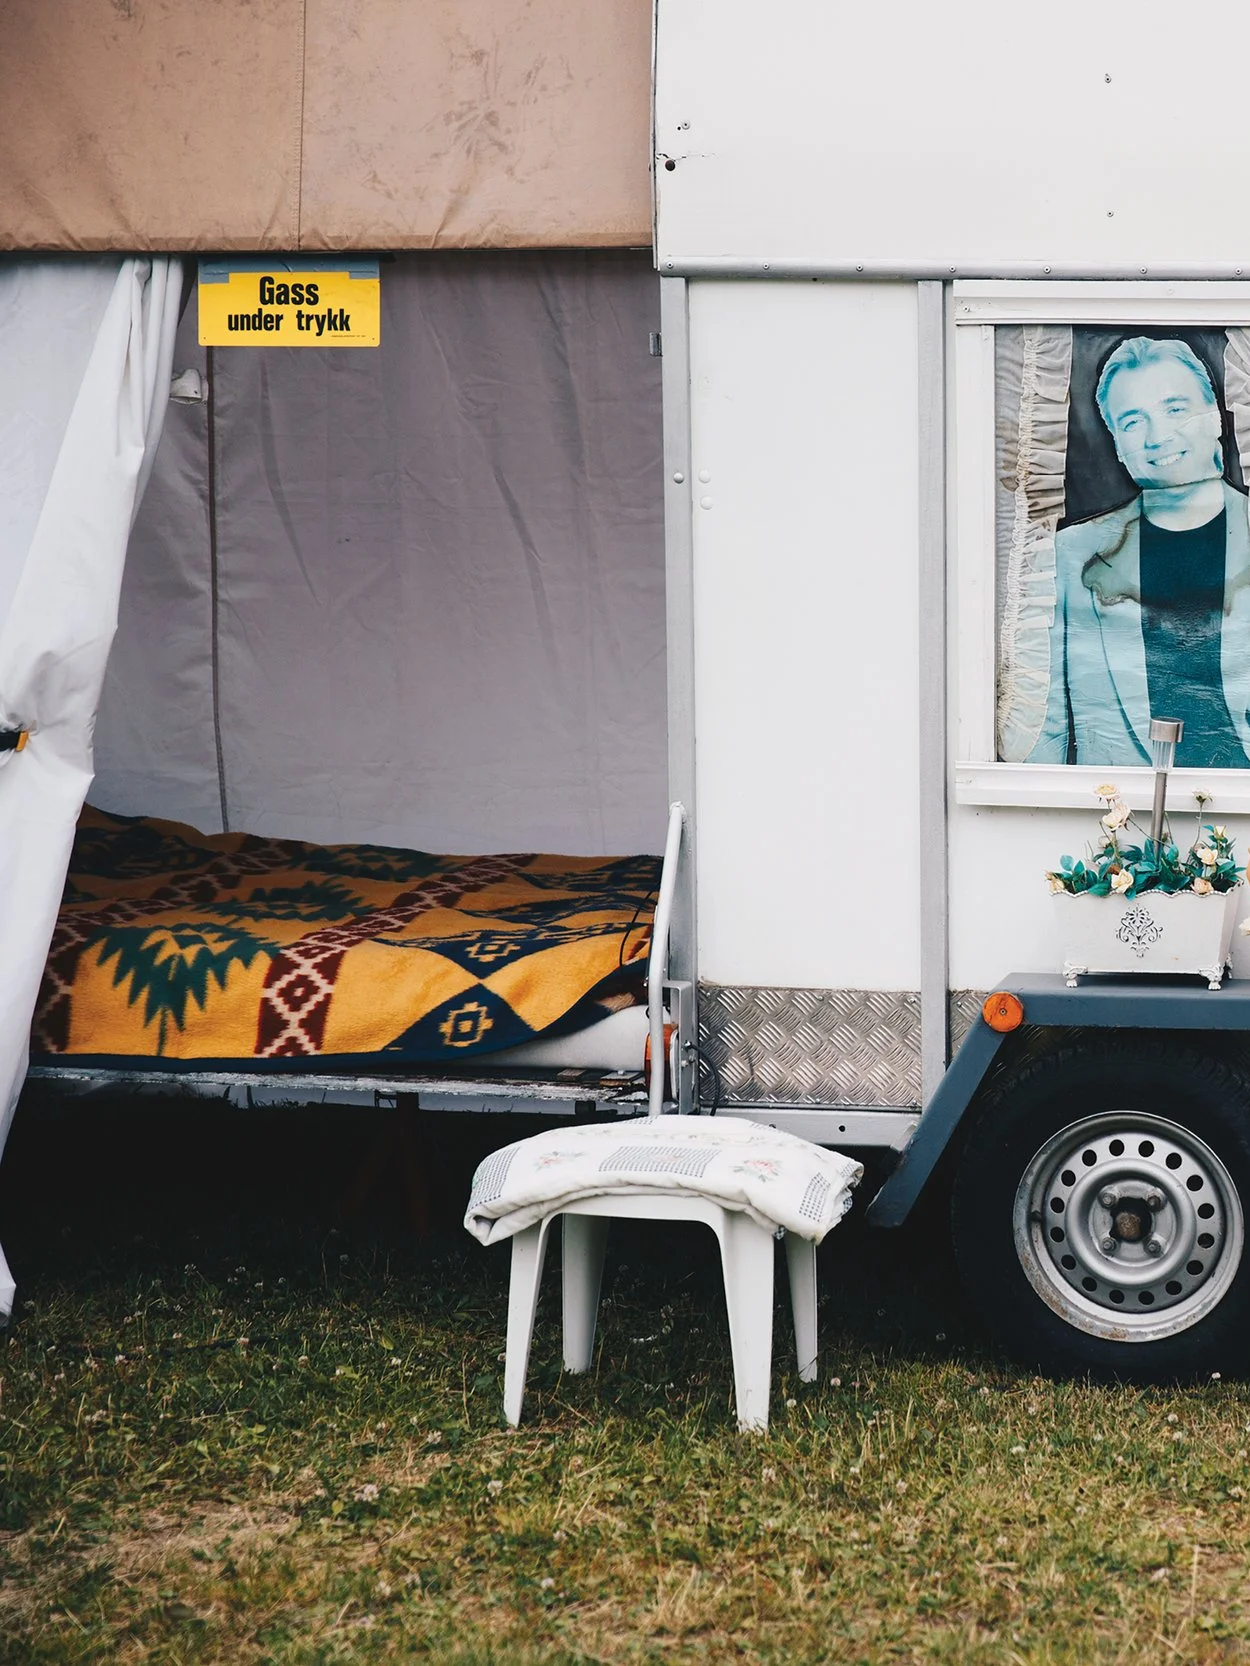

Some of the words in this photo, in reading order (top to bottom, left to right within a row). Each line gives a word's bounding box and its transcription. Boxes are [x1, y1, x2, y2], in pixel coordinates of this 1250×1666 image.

[260, 276, 319, 305] Gass
[228, 308, 283, 331] under
[296, 309, 350, 336] trykk
